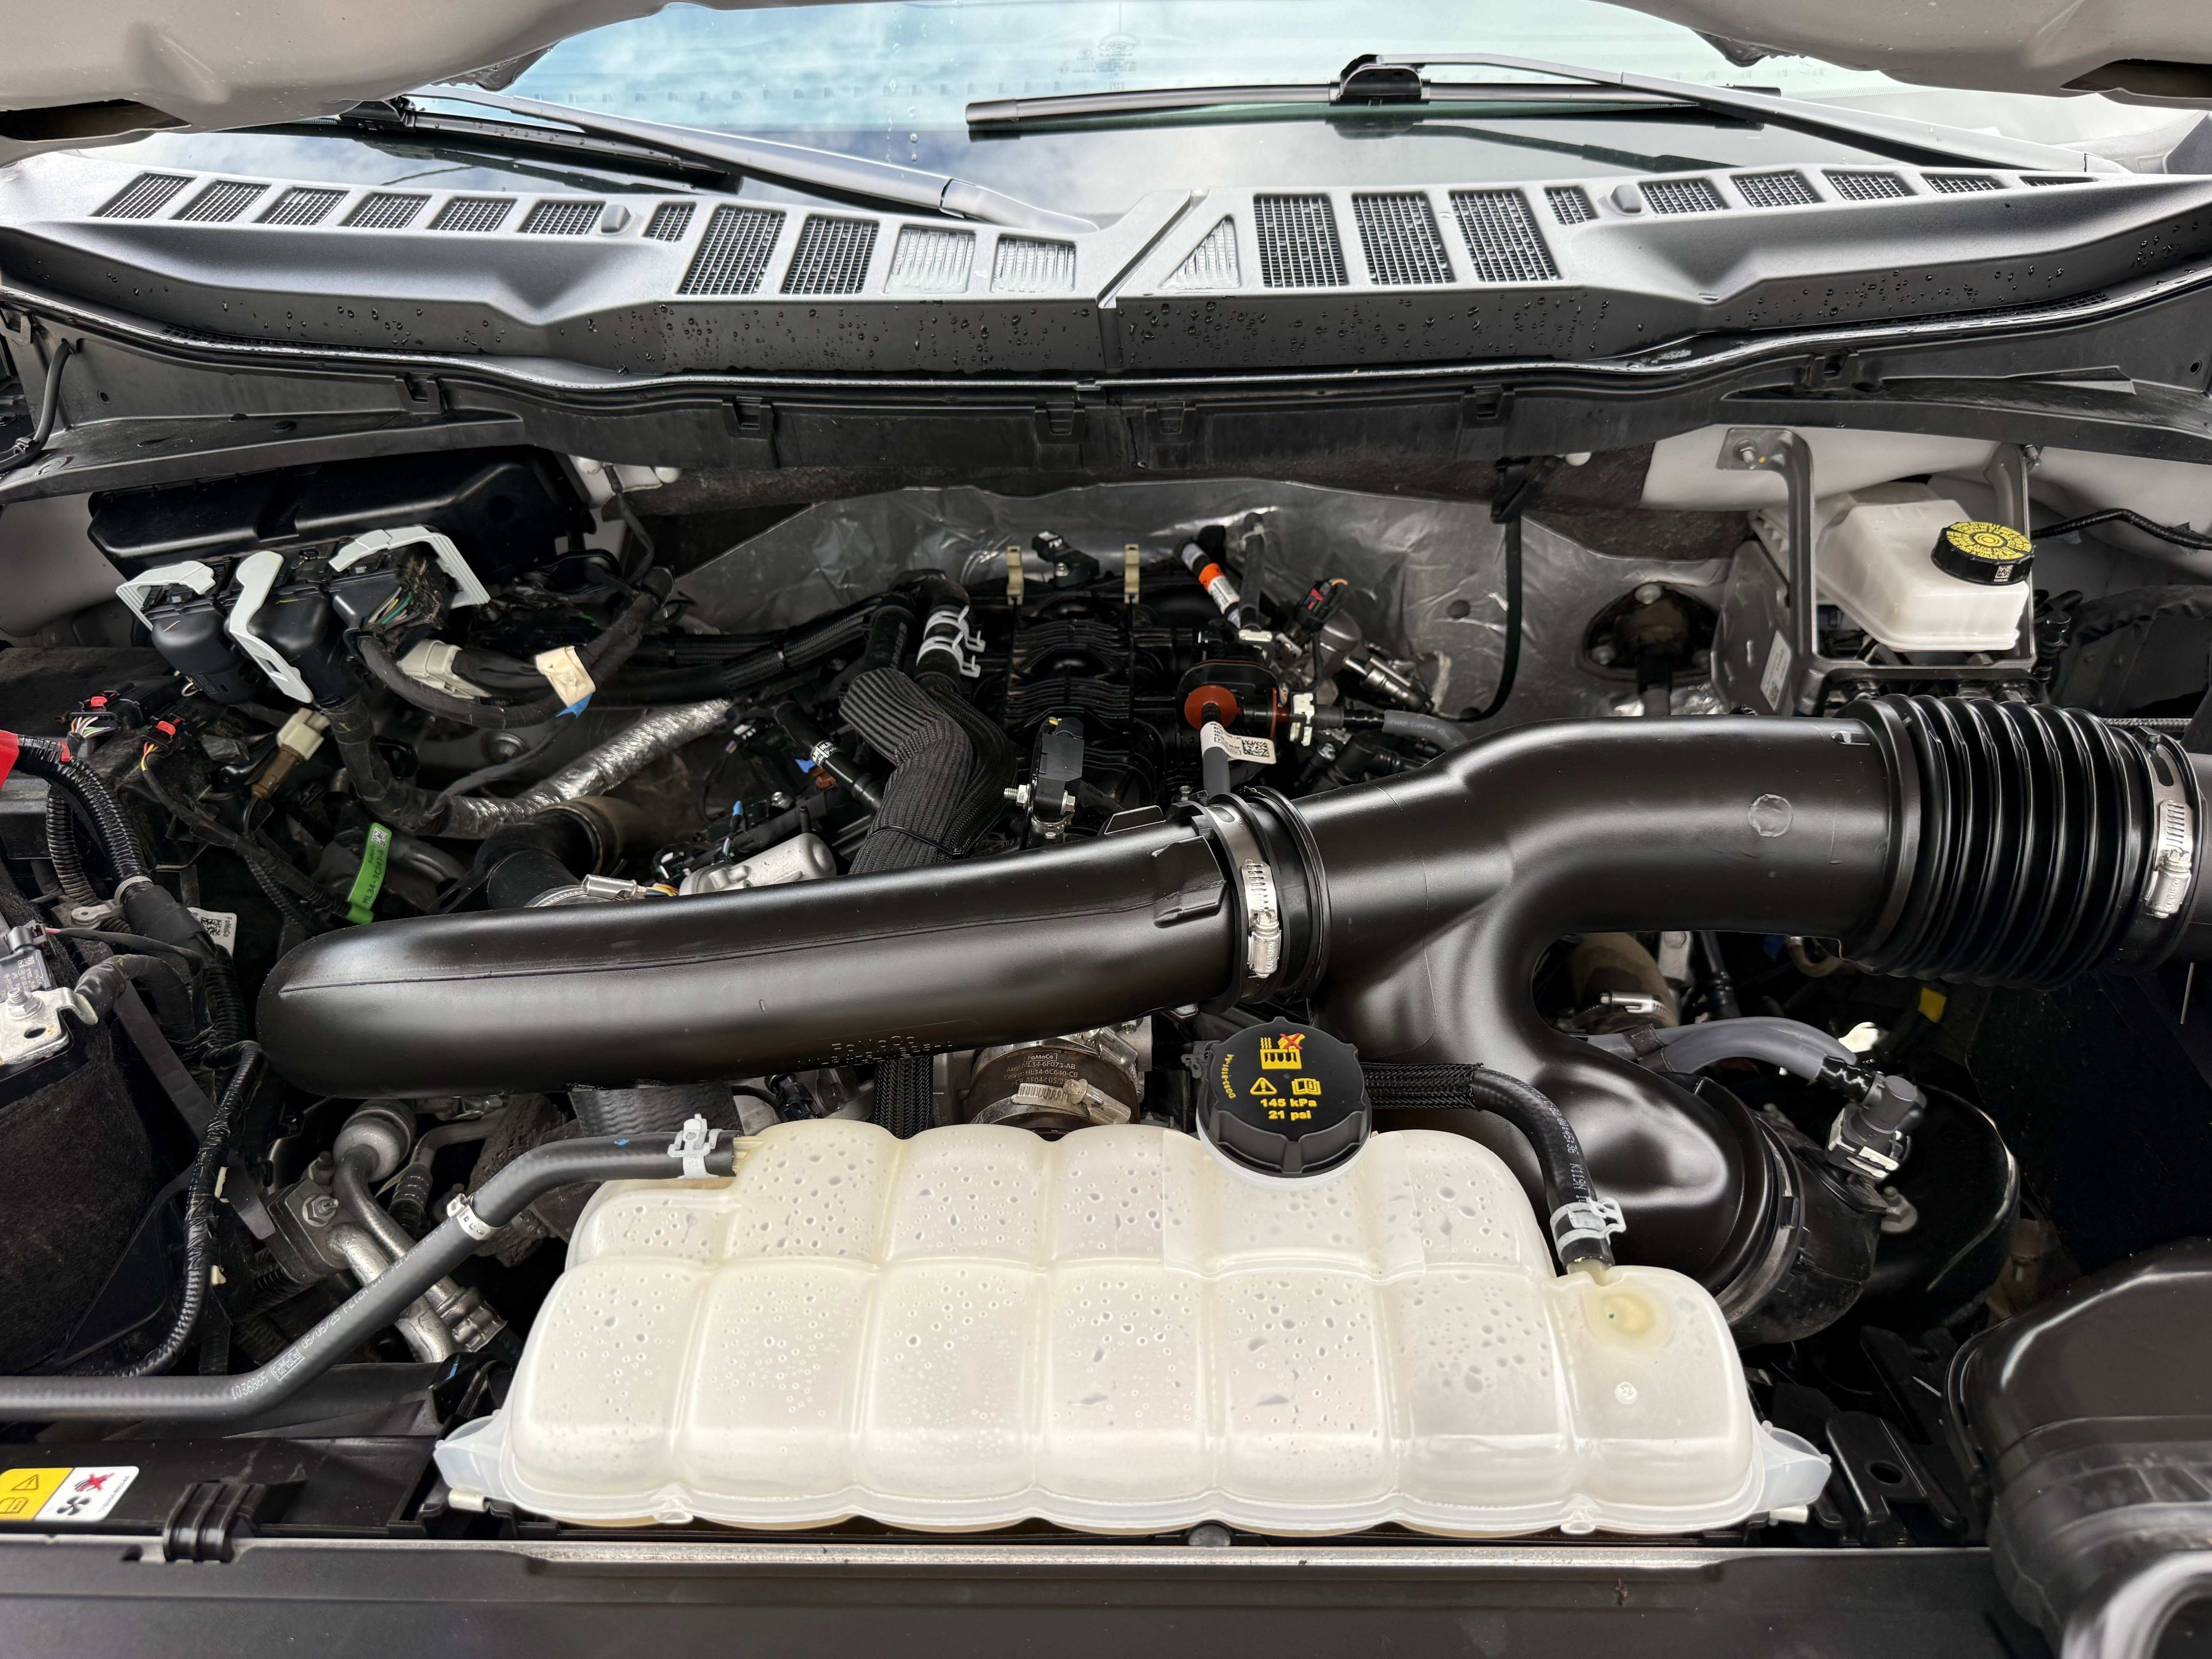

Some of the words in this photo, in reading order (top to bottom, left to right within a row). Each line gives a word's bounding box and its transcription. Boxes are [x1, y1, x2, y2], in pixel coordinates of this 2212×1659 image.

[1025, 1069, 1079, 1078] HL34-6C640-CB
[1260, 1098, 1286, 1108] 145
[1290, 1098, 1317, 1108] kPa
[1268, 1110, 1285, 1120] 21
[1290, 1110, 1312, 1121] psi
[301, 1311, 341, 1348] 05/05/25
